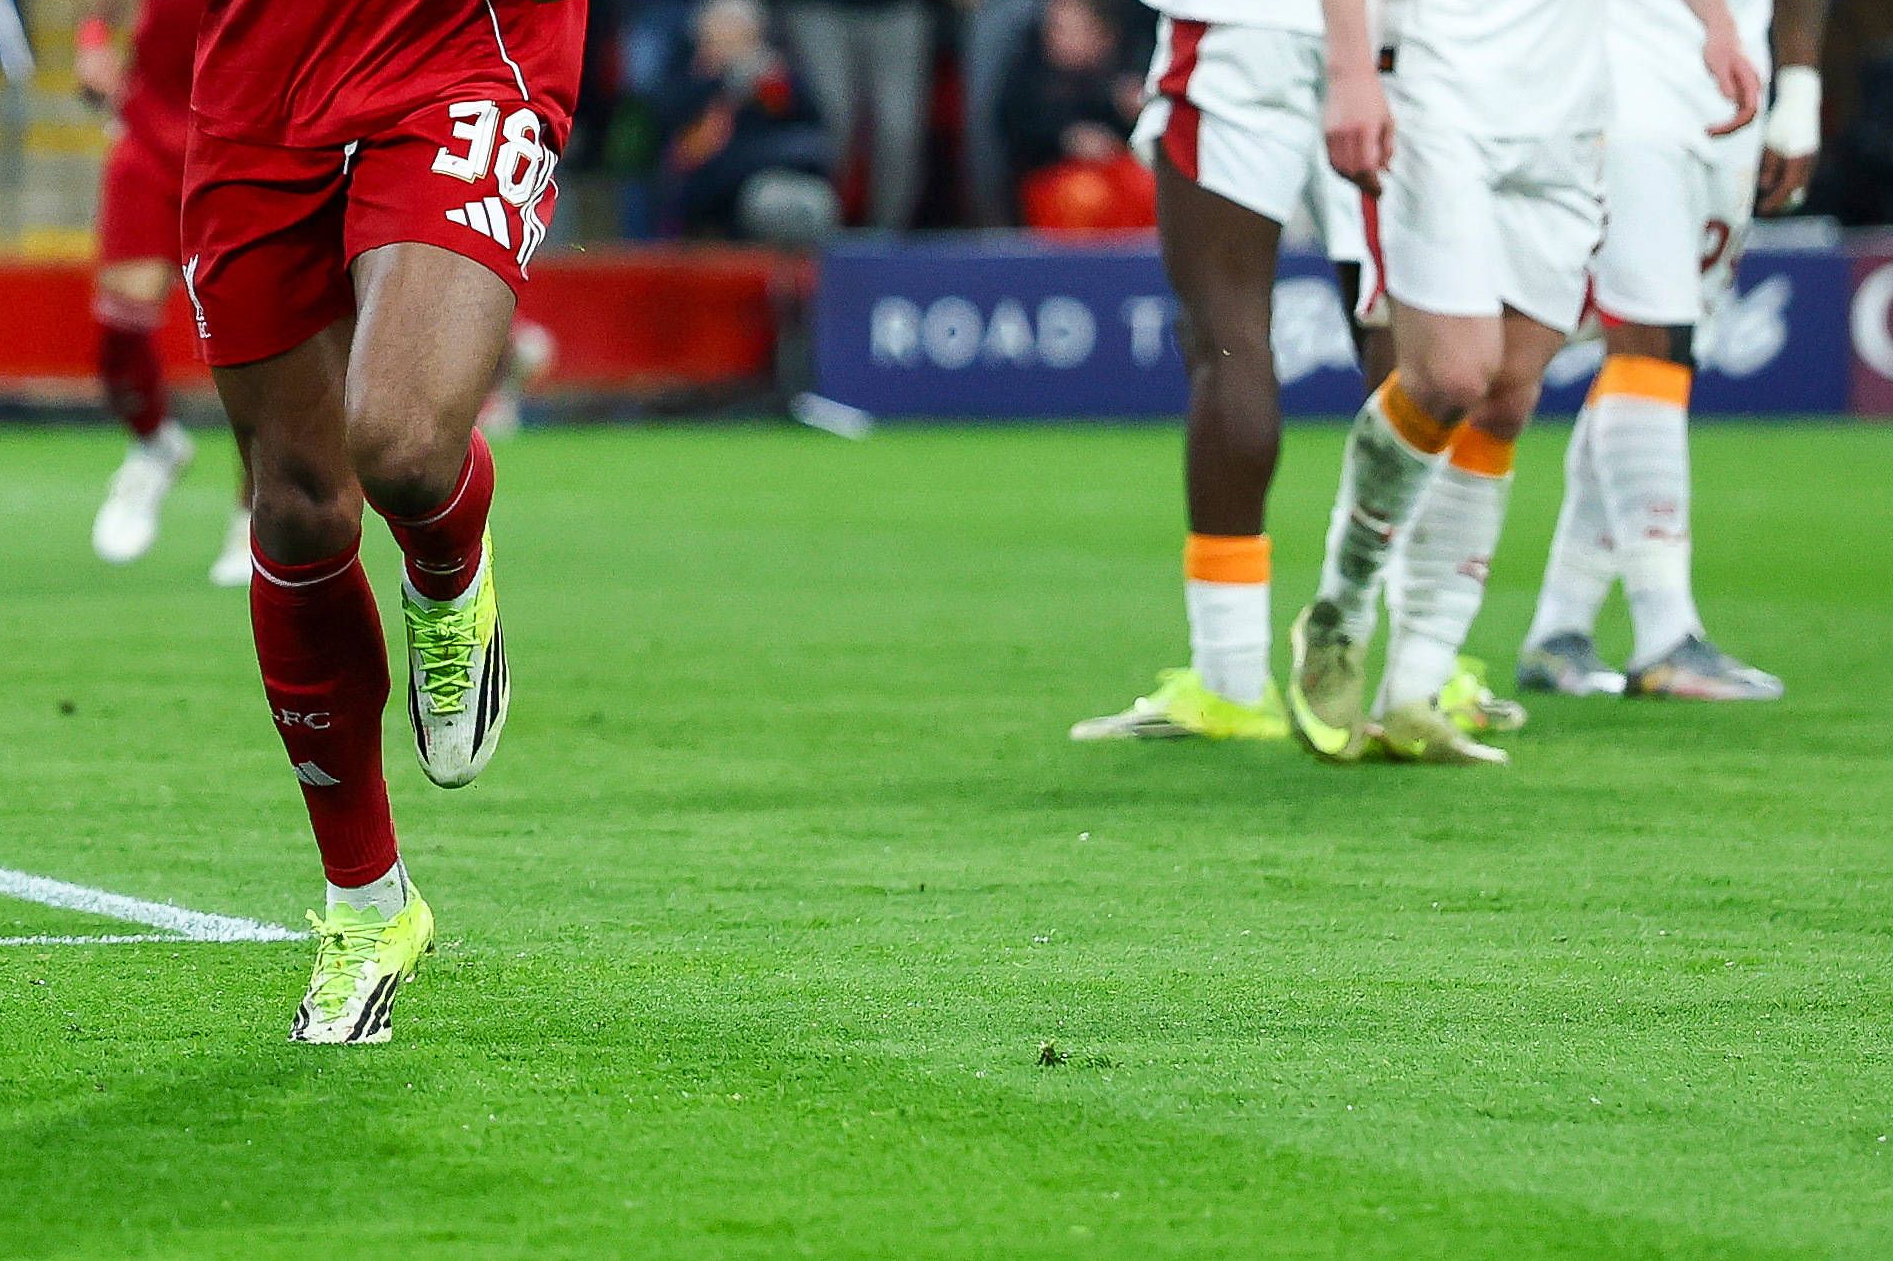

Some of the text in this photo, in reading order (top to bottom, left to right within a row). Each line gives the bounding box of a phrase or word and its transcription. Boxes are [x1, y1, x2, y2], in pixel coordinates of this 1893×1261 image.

[431, 99, 544, 208] 38
[869, 294, 1098, 370] ROAD
[274, 708, 331, 730] FC
